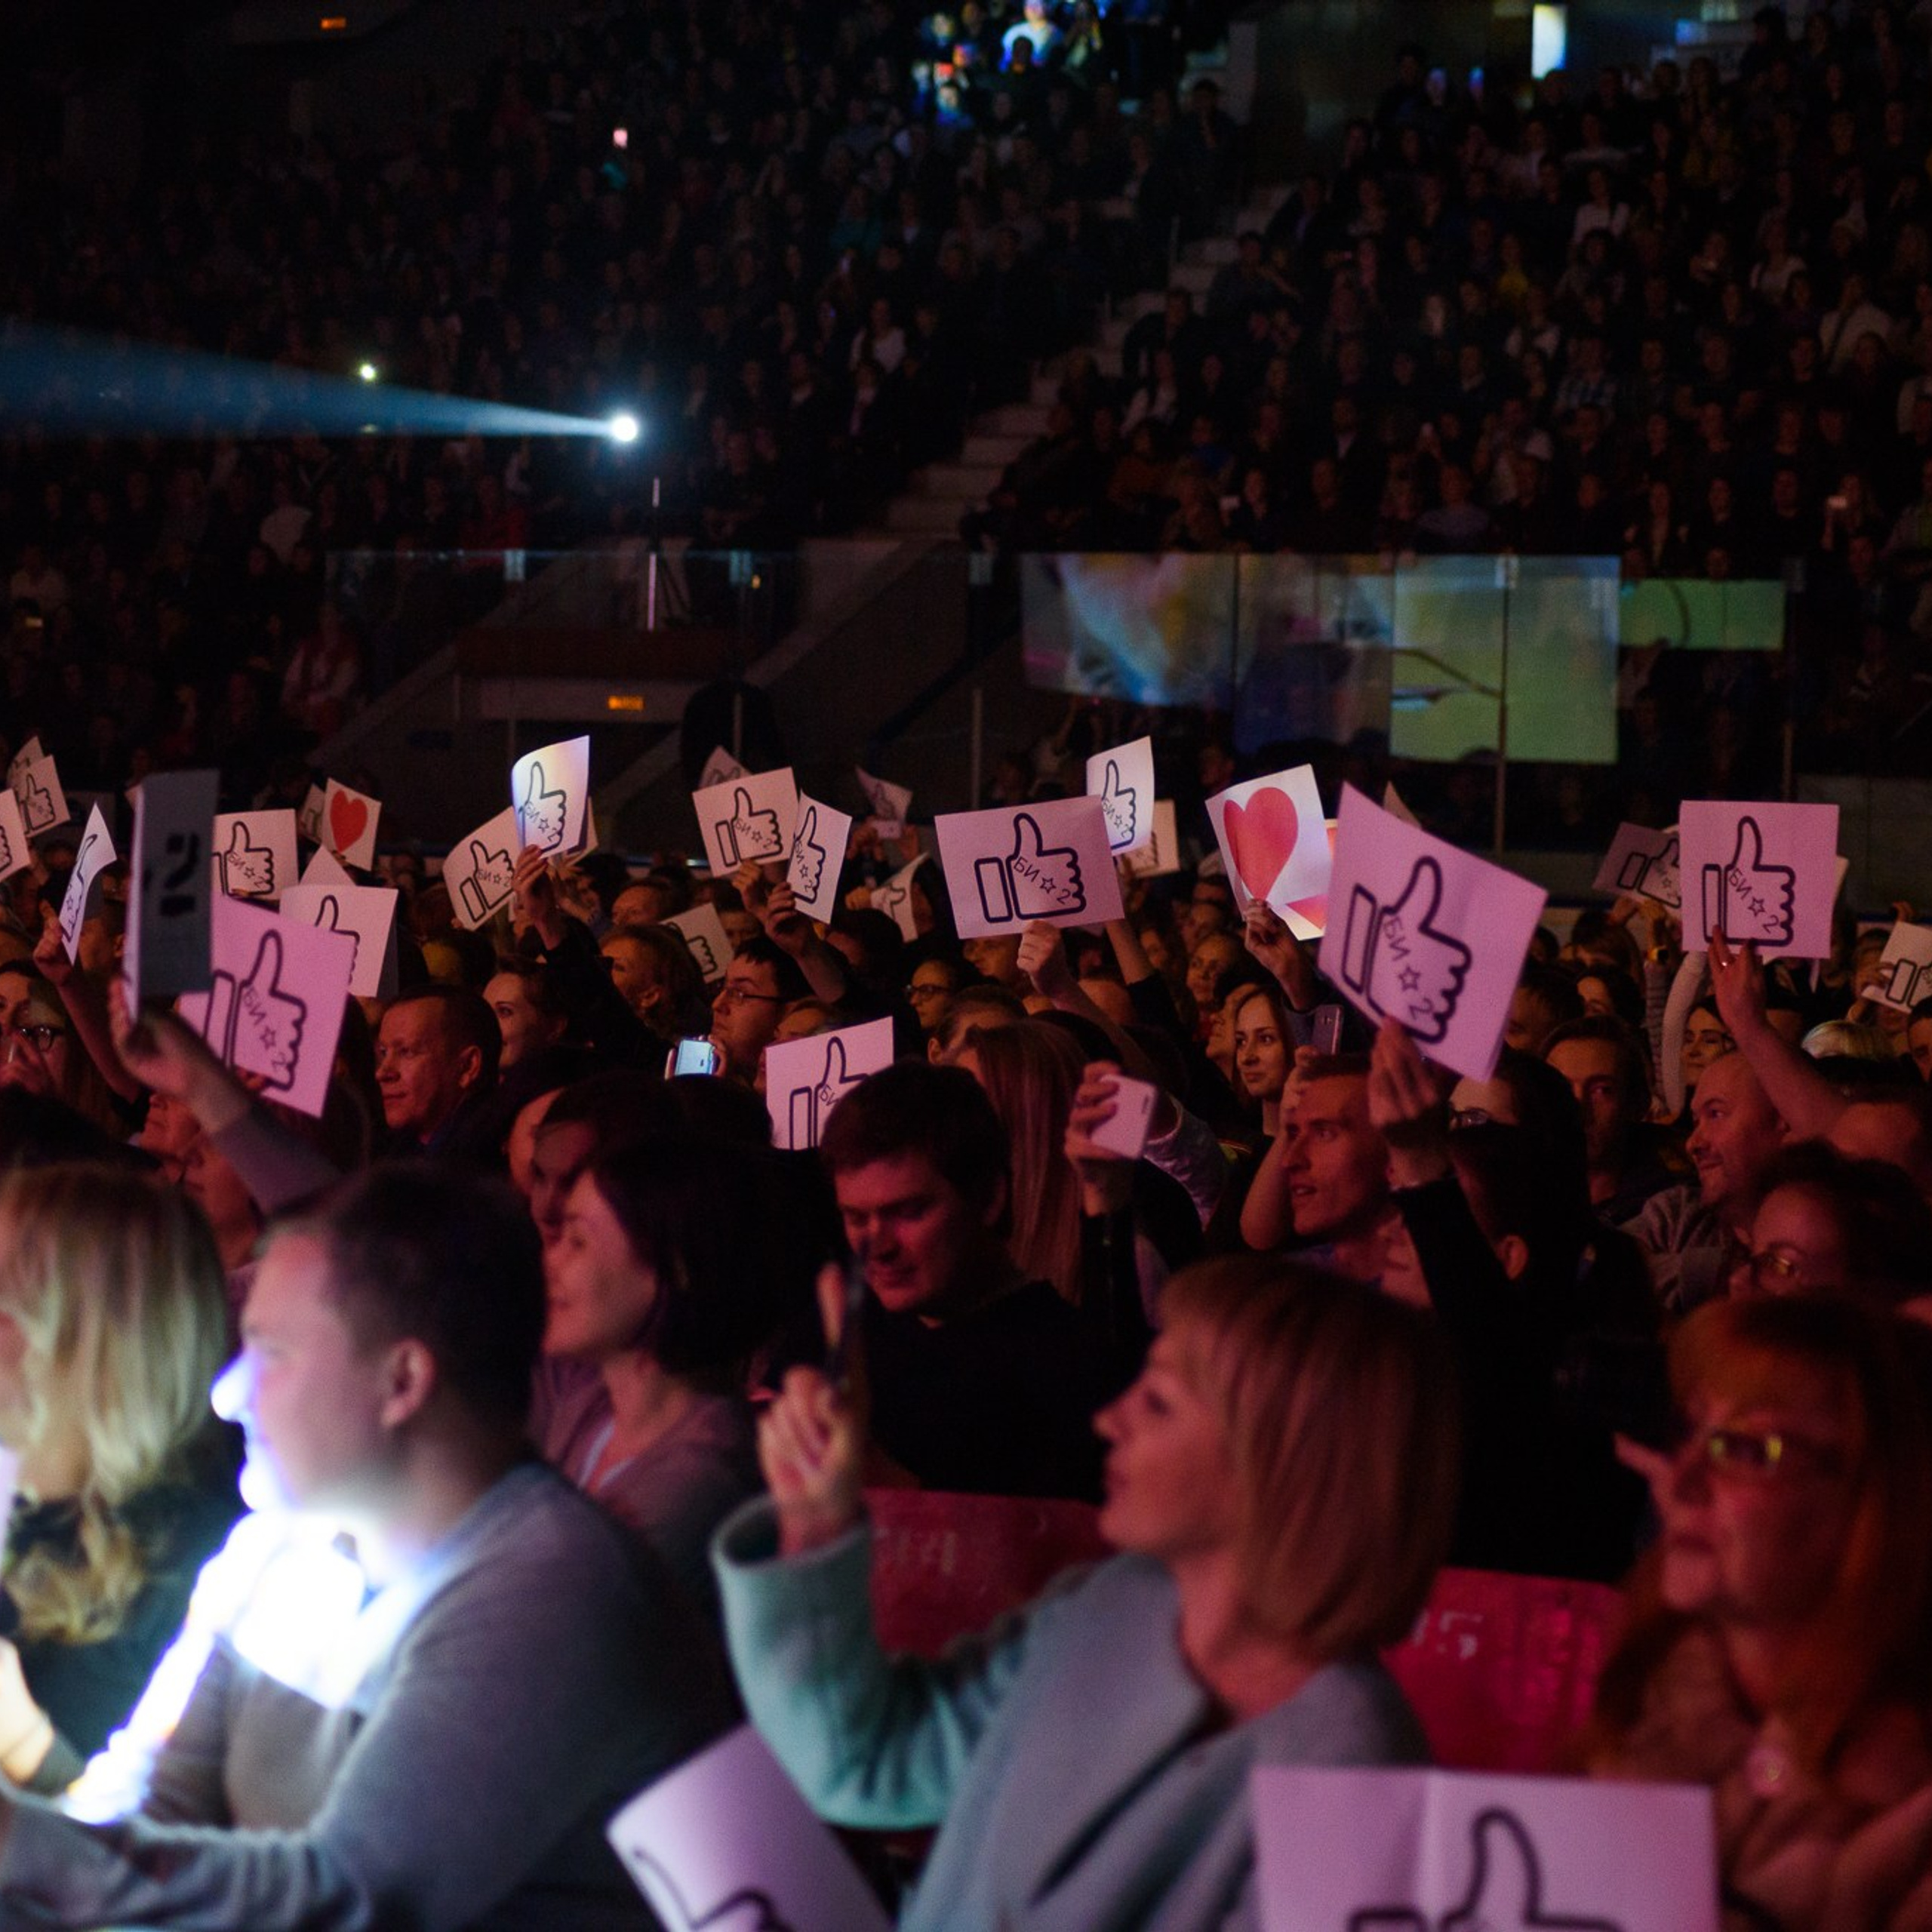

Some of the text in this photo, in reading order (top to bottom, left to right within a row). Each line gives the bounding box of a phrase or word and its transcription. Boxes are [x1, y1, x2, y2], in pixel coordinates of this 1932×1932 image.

[734, 818, 774, 851] БИ 2
[1014, 857, 1072, 906] БИ 2
[1729, 868, 1780, 934] БИ 2
[1383, 915, 1433, 1020] БИ 2
[242, 986, 287, 1071] БИ 2
